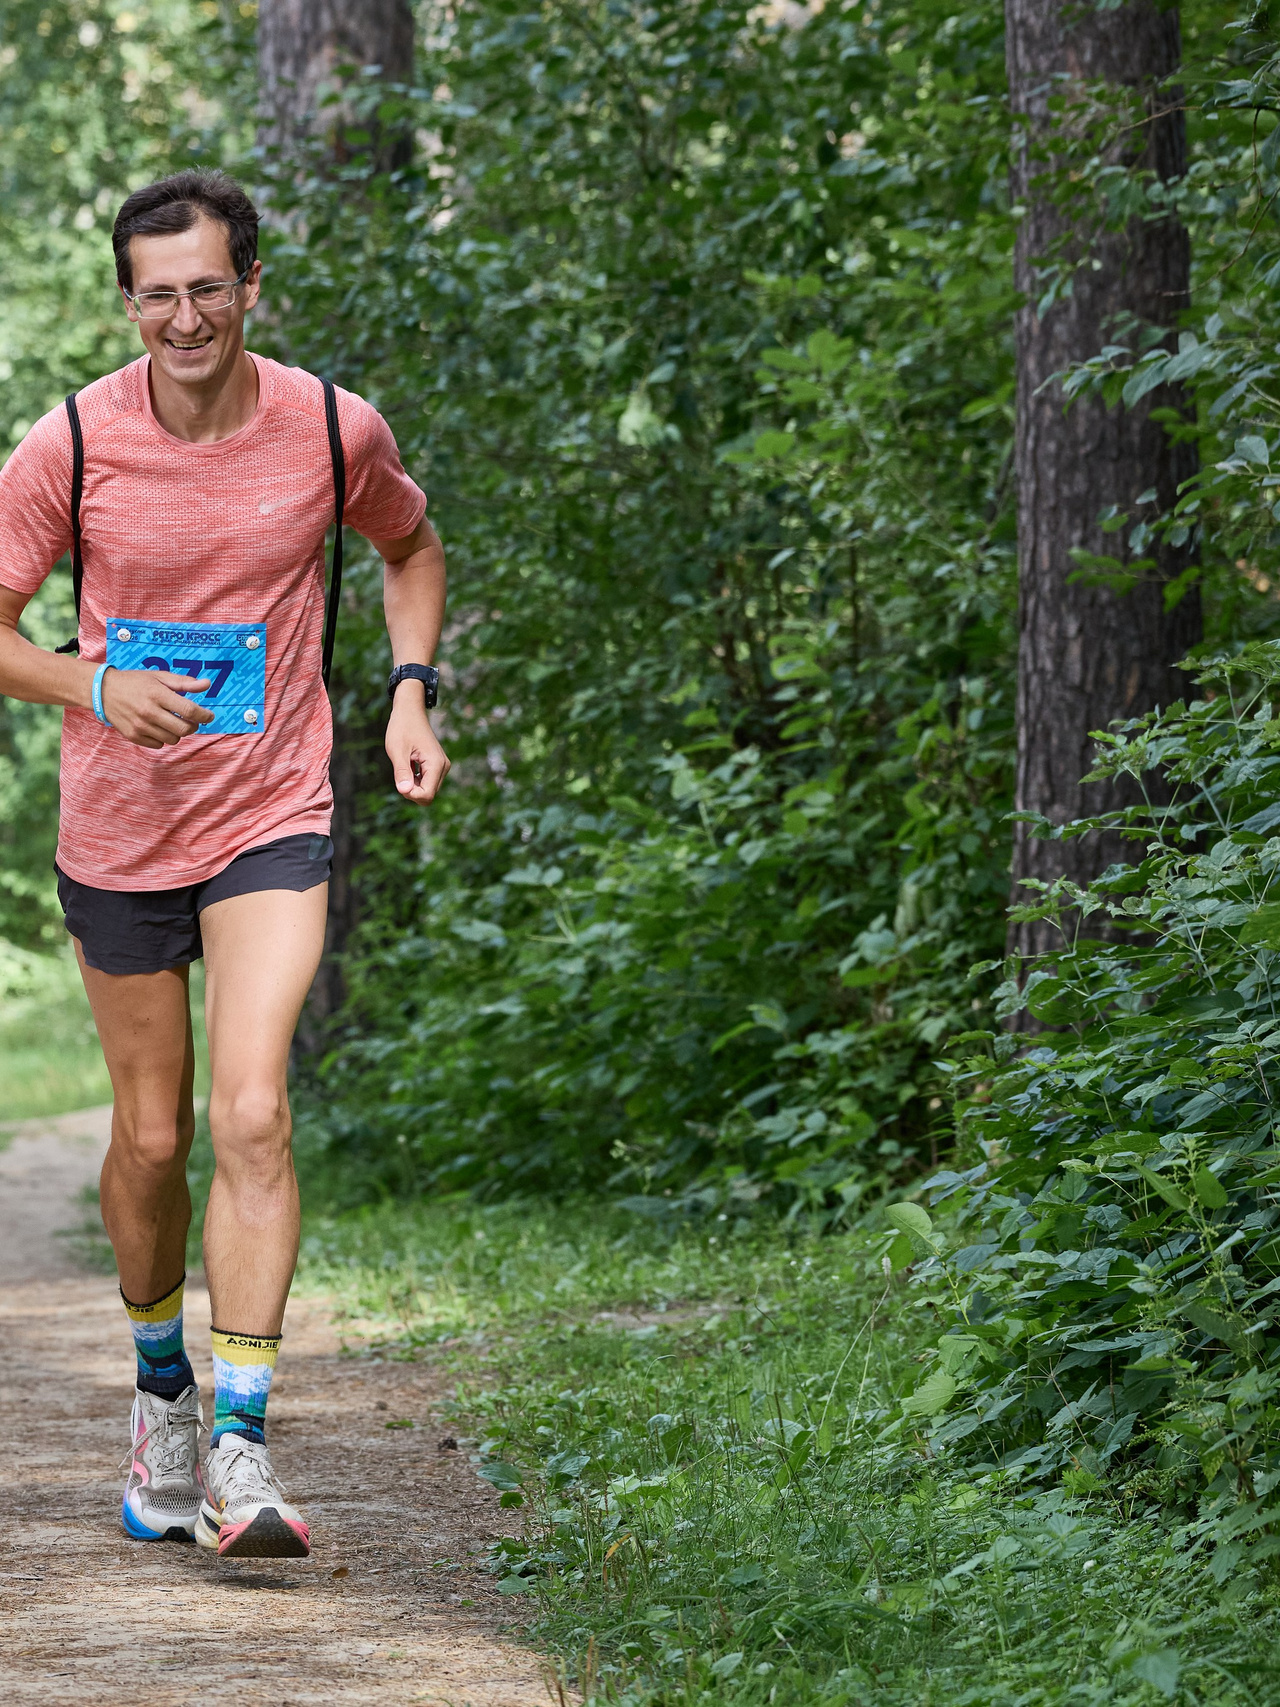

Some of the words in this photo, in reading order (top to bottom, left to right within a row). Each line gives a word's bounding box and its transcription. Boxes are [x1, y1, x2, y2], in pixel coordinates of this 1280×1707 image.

[153, 630, 185, 640] РЕТРО
[186, 632, 221, 642] КРОСС
[226, 1337, 280, 1350] AONIJIE
